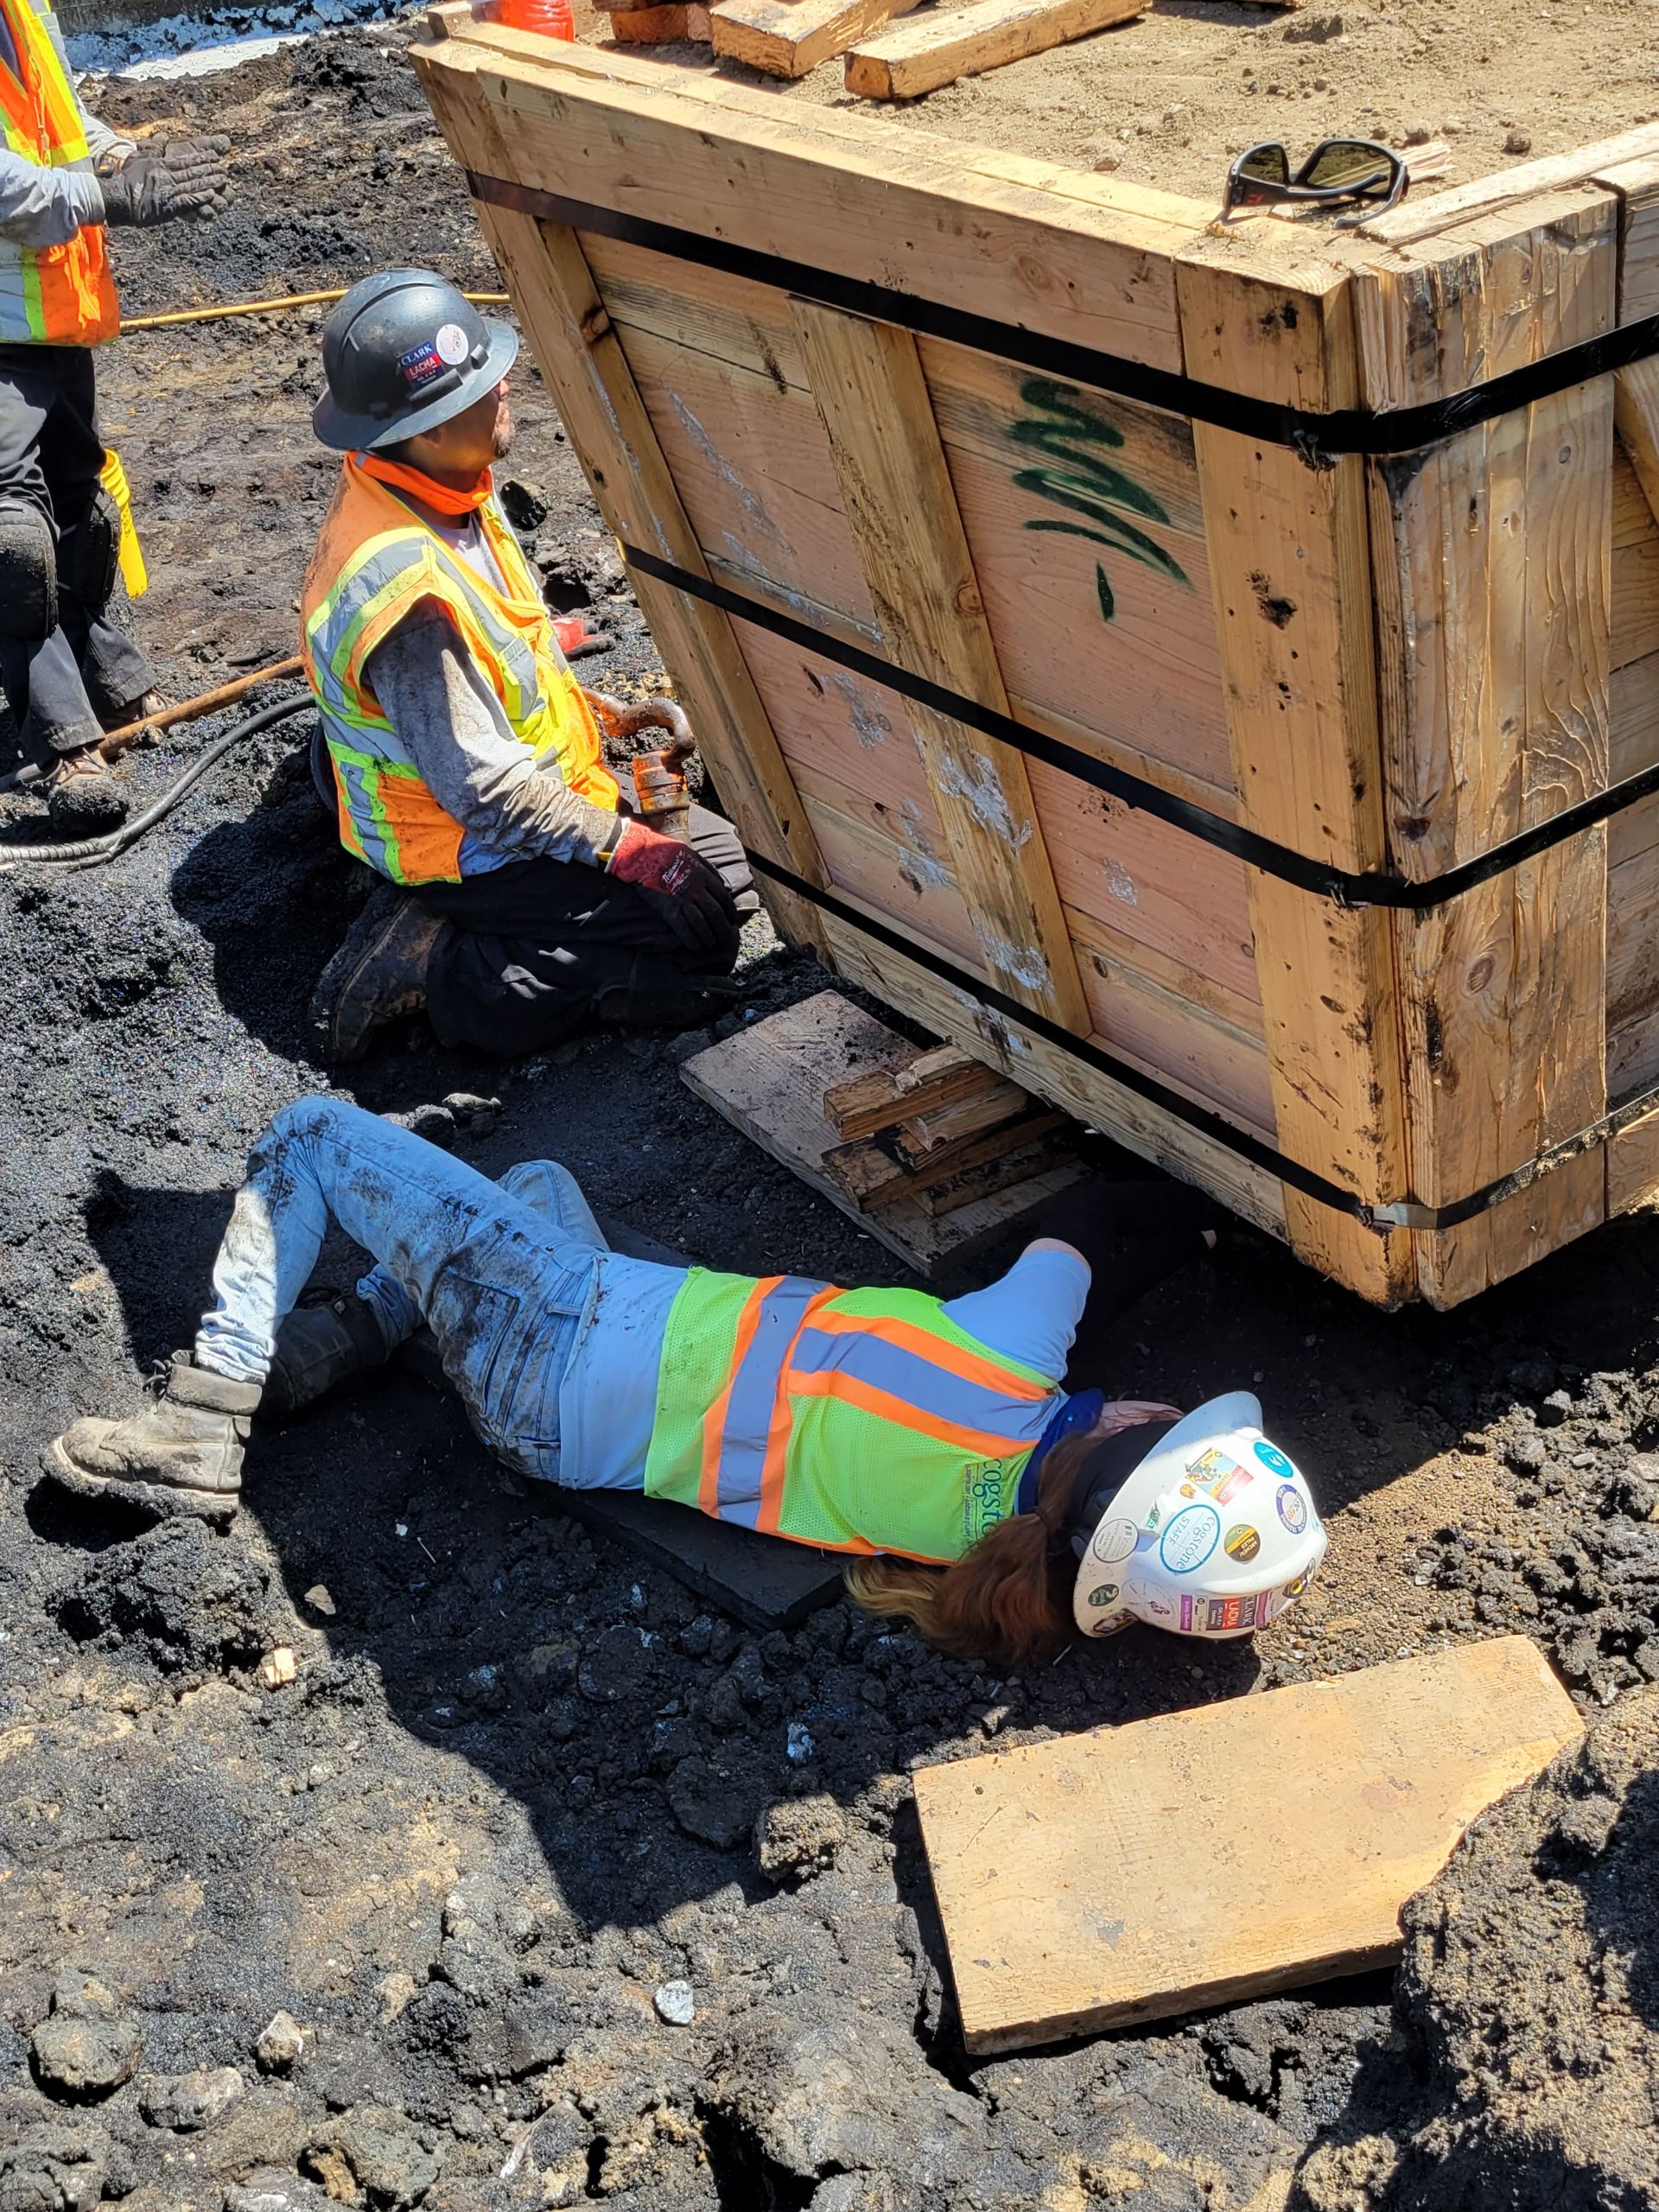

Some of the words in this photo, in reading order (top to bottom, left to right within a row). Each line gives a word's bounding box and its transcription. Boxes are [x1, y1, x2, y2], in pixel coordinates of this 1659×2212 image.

[401, 344, 432, 365] CLARK
[409, 357, 436, 376] LACMA
[972, 1459, 1003, 1535] cogst
[1169, 1516, 1190, 1546] STAFF
[1227, 1601, 1239, 1627] LACMA
[1243, 1596, 1255, 1625] CLARK
